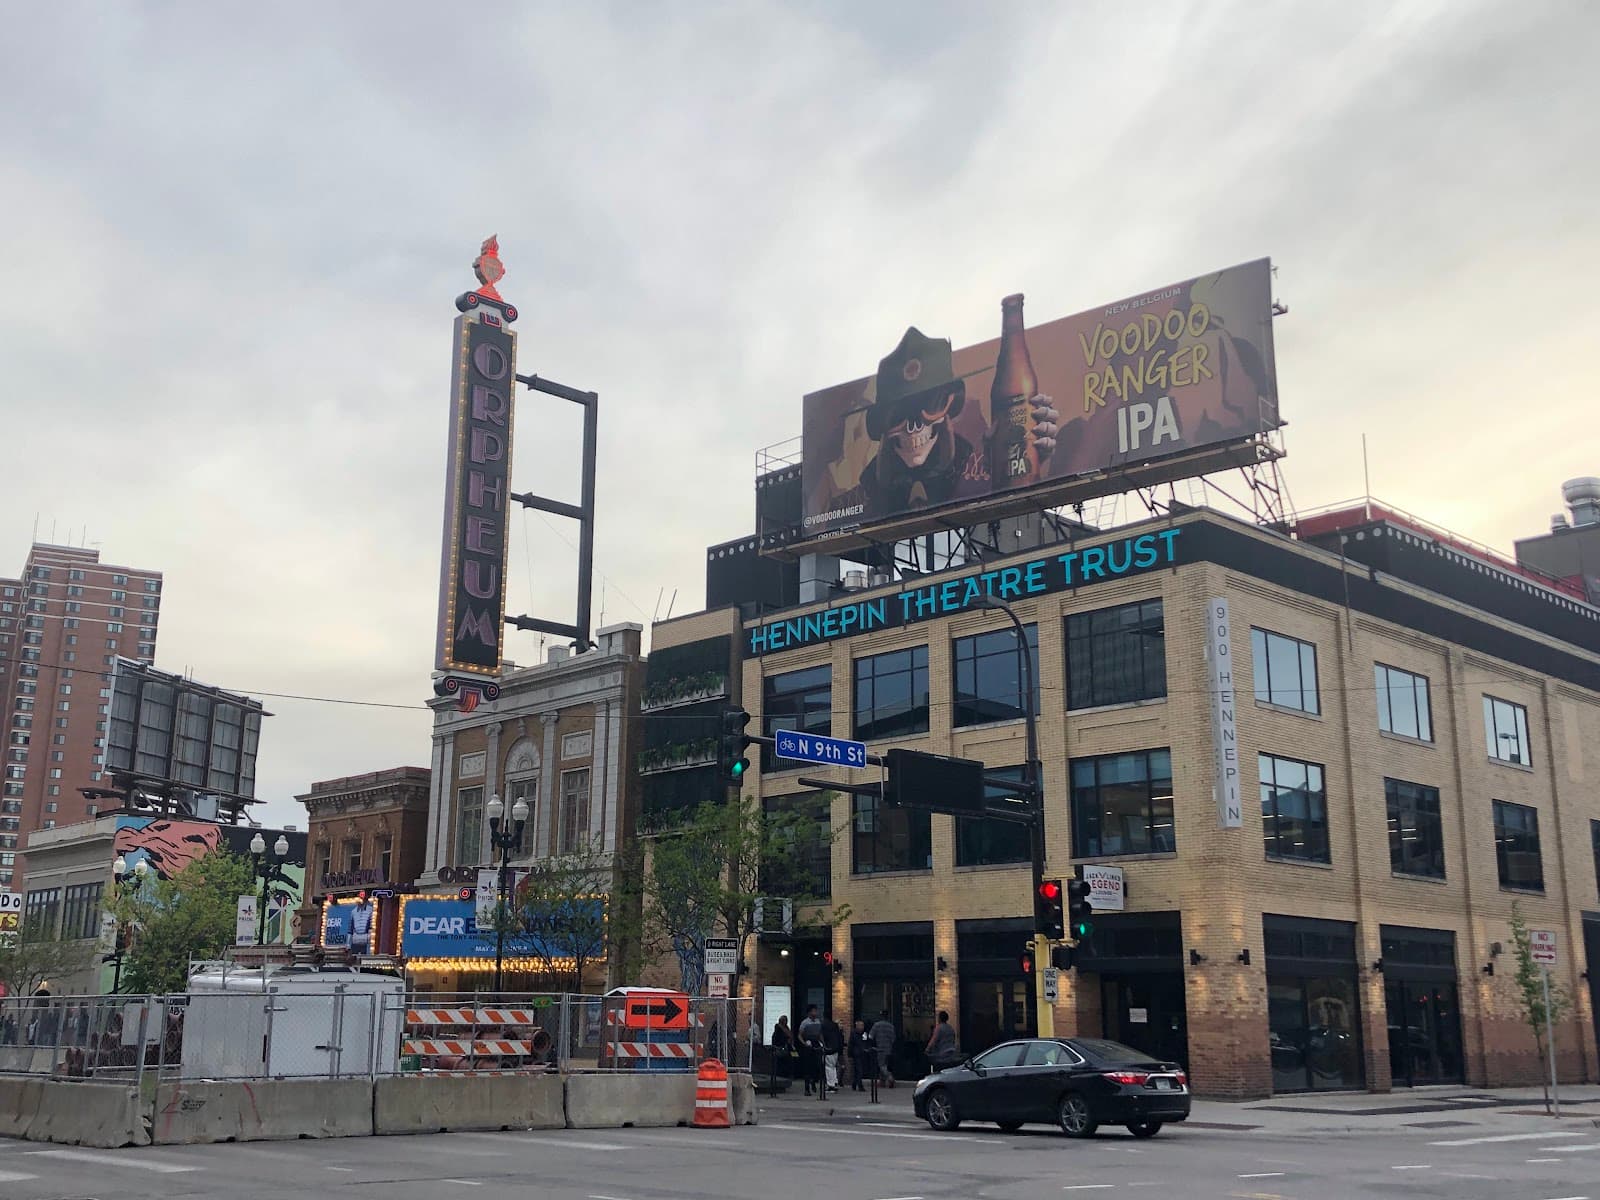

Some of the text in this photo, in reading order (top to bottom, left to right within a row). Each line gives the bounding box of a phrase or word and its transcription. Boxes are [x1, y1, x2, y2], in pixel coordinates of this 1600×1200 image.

[1105, 287, 1181, 317] NEW BELGIUM
[1079, 303, 1210, 367] VOODOO
[1084, 343, 1213, 412] RANGER
[1117, 396, 1180, 453] IPA
[456, 341, 508, 647] ORPHEUM
[804, 504, 864, 528] @VOODOORANGER
[750, 528, 1181, 654] HENNEPIN THEATRE TRUST
[1216, 606, 1240, 820] 900 HENNEPIN
[798, 739, 863, 763] N 9th St
[1090, 880, 1120, 891] EGEND
[326, 917, 342, 928] DEAR
[409, 917, 464, 934] DEAR
[1045, 970, 1056, 978] ONE
[1045, 980, 1056, 988] WAY
